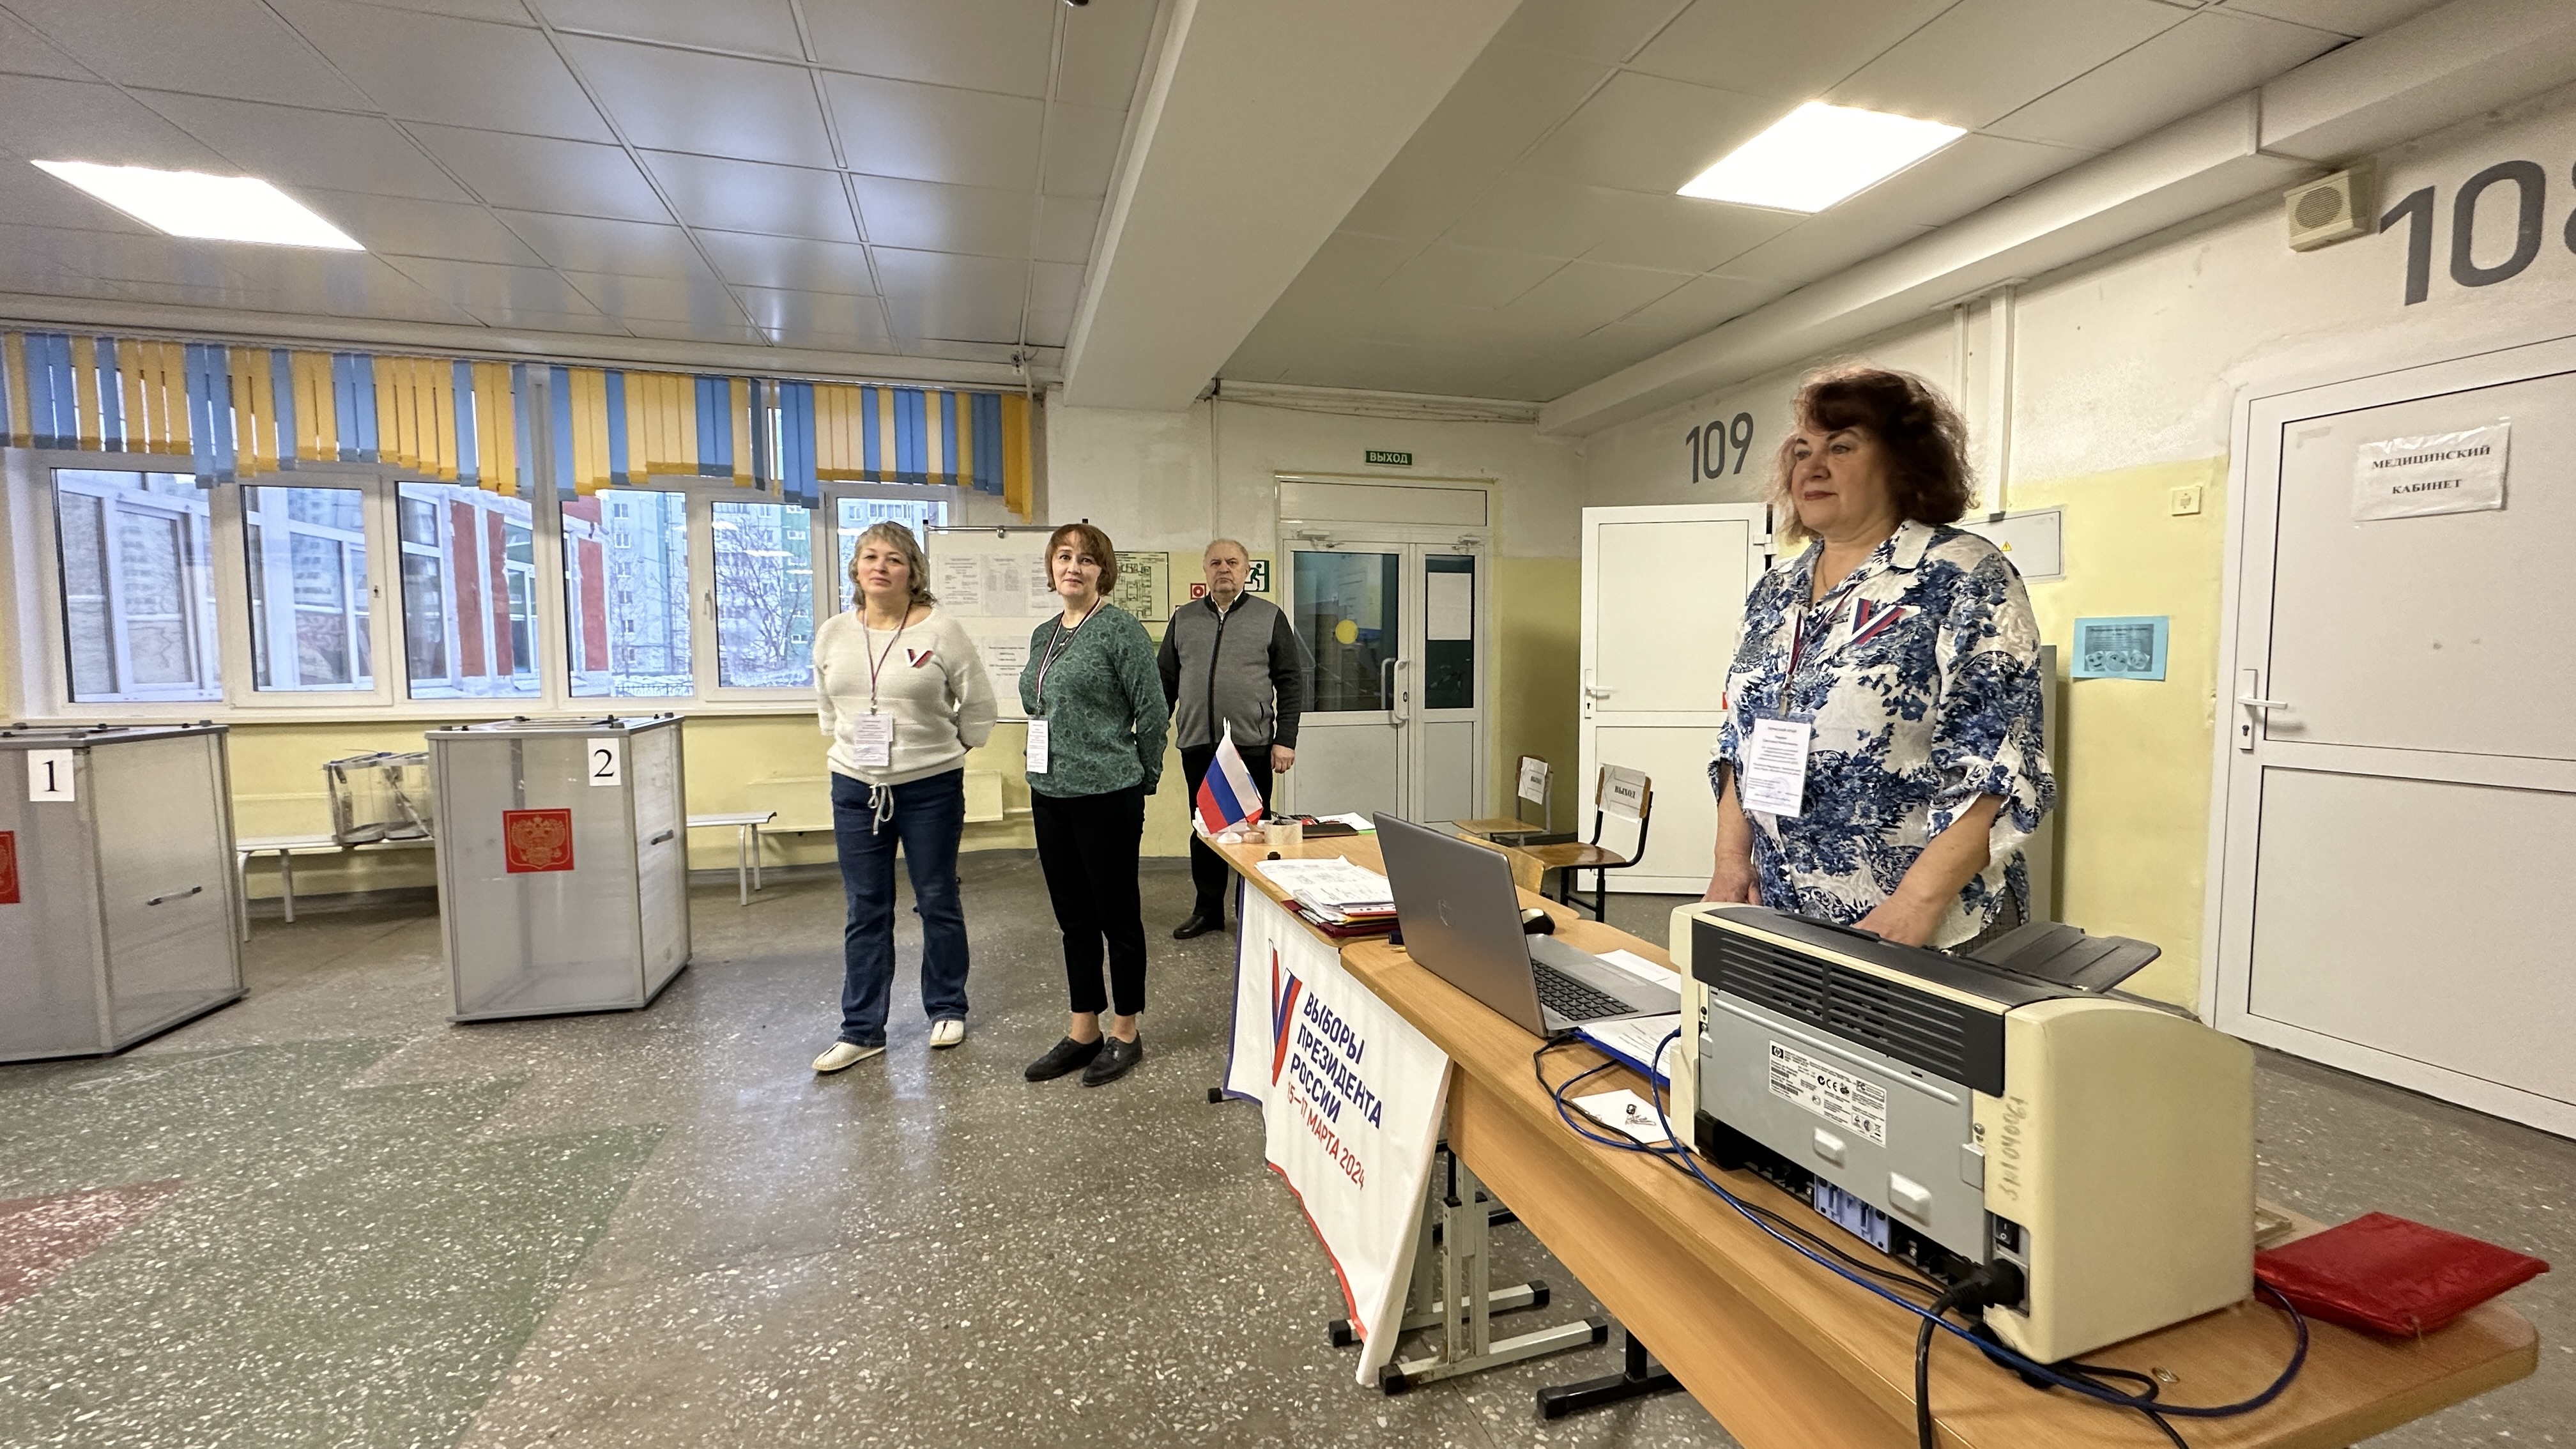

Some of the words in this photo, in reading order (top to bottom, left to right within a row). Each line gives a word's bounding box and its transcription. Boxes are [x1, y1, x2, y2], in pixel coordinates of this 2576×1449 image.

[2379, 160, 2576, 306] 10
[1370, 452, 1408, 464] ВЫХОД
[1685, 412, 1754, 484] 109
[2372, 445, 2490, 470] МЕДИЦИНСКИЙ
[2392, 479, 2463, 494] КАБИНЕТ
[42, 760, 62, 792] 1
[594, 749, 615, 778] 2
[1614, 785, 1636, 799] ВЫХОД
[1303, 991, 1365, 1065] ВЫБОРЫ
[1290, 1052, 1342, 1124] РОССИИ
[1296, 1022, 1383, 1130] ПРЕЗИДЕНТА
[1306, 1107, 1340, 1160] МАРТА
[1339, 1147, 1365, 1191] 2024
